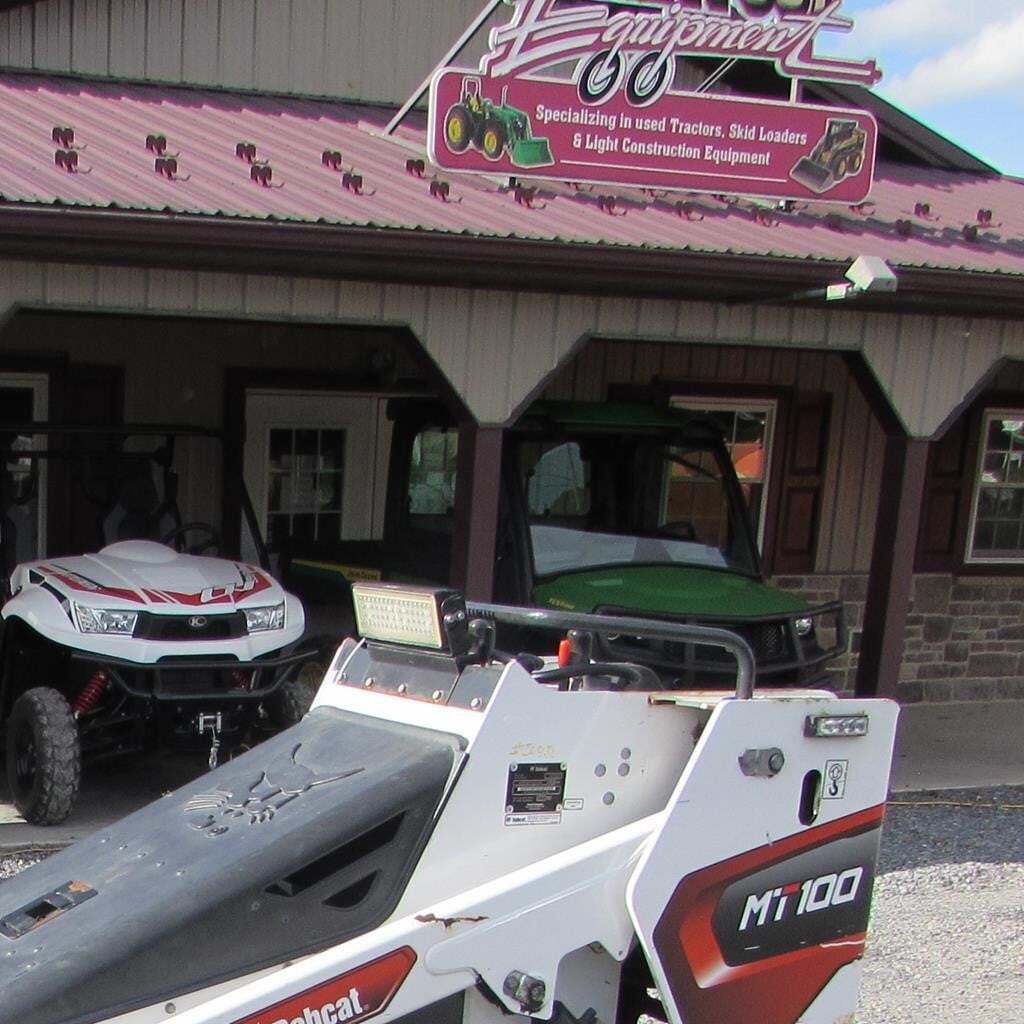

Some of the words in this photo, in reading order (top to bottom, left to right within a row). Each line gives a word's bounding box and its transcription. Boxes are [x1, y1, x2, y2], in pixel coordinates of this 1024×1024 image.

[491, 0, 873, 88] Equipment
[536, 104, 617, 131] Specializing
[619, 112, 632, 129] in
[635, 116, 666, 132] used
[728, 123, 756, 141] Skid
[758, 126, 808, 146] Loaders
[573, 132, 582, 149] &
[584, 133, 619, 154] Light
[622, 137, 701, 160] Construction
[703, 144, 771, 166] Equipment
